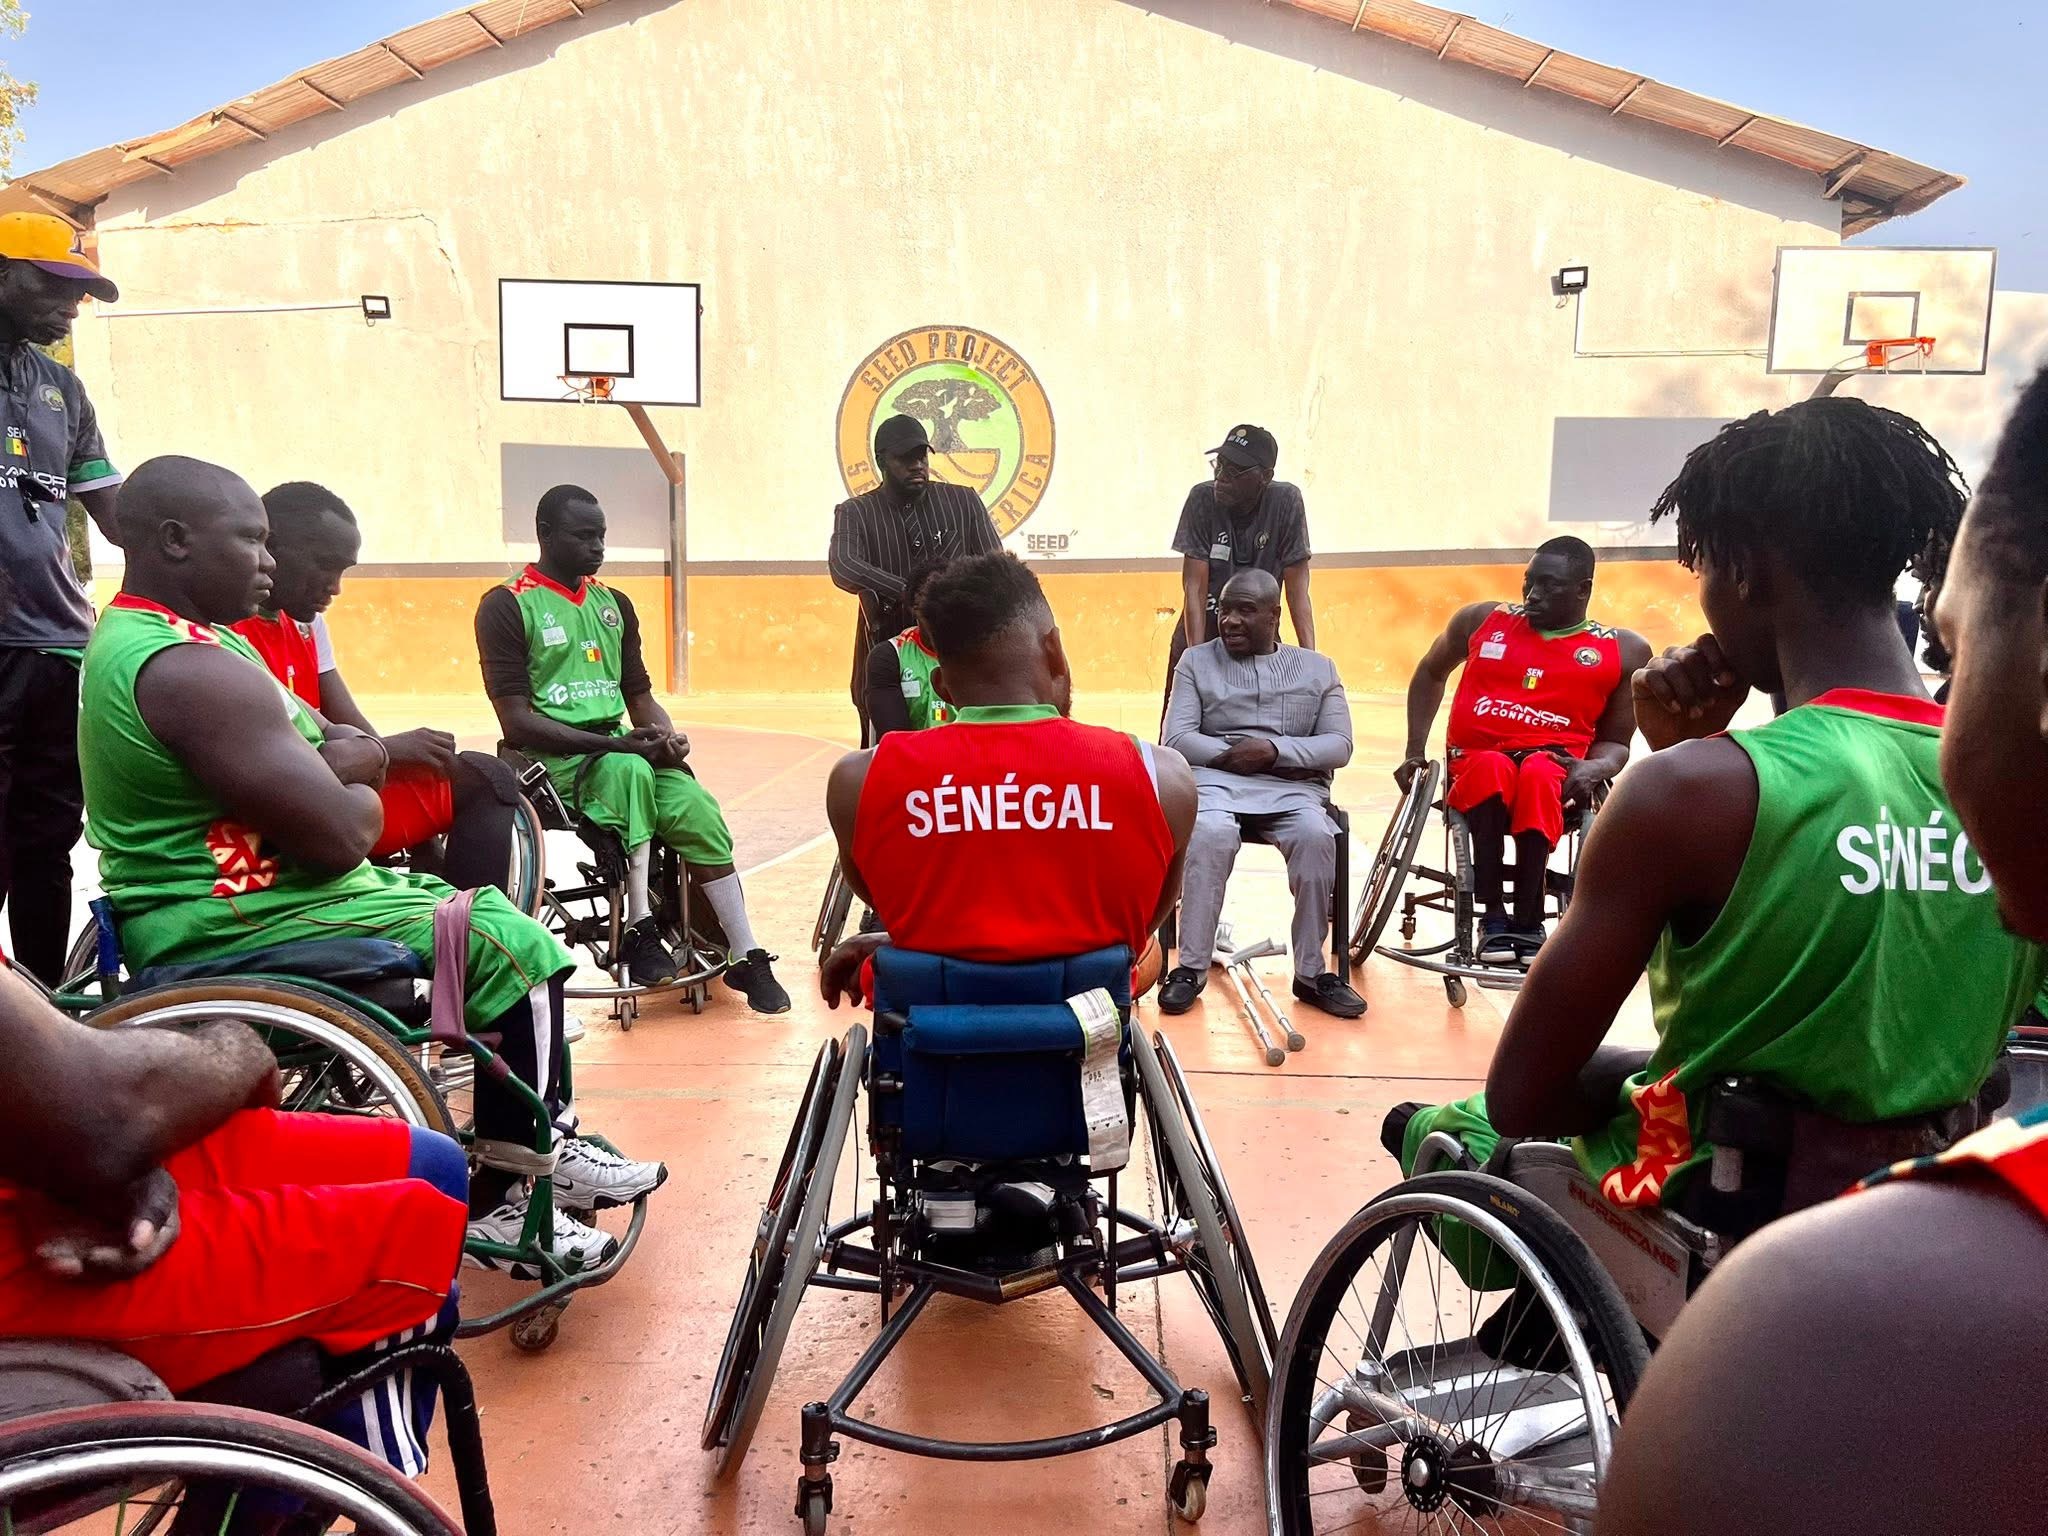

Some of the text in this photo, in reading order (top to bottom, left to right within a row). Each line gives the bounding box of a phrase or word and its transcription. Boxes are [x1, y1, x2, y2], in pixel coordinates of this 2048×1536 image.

[861, 332, 1031, 394] SEED PROJECT
[1526, 667, 1544, 678] SEN
[1491, 707, 1561, 731] CONFECTIO
[1495, 699, 1571, 727] TANOR
[905, 772, 1113, 838] SÉNÉGAL
[1836, 805, 1993, 895] SÉNÉG
